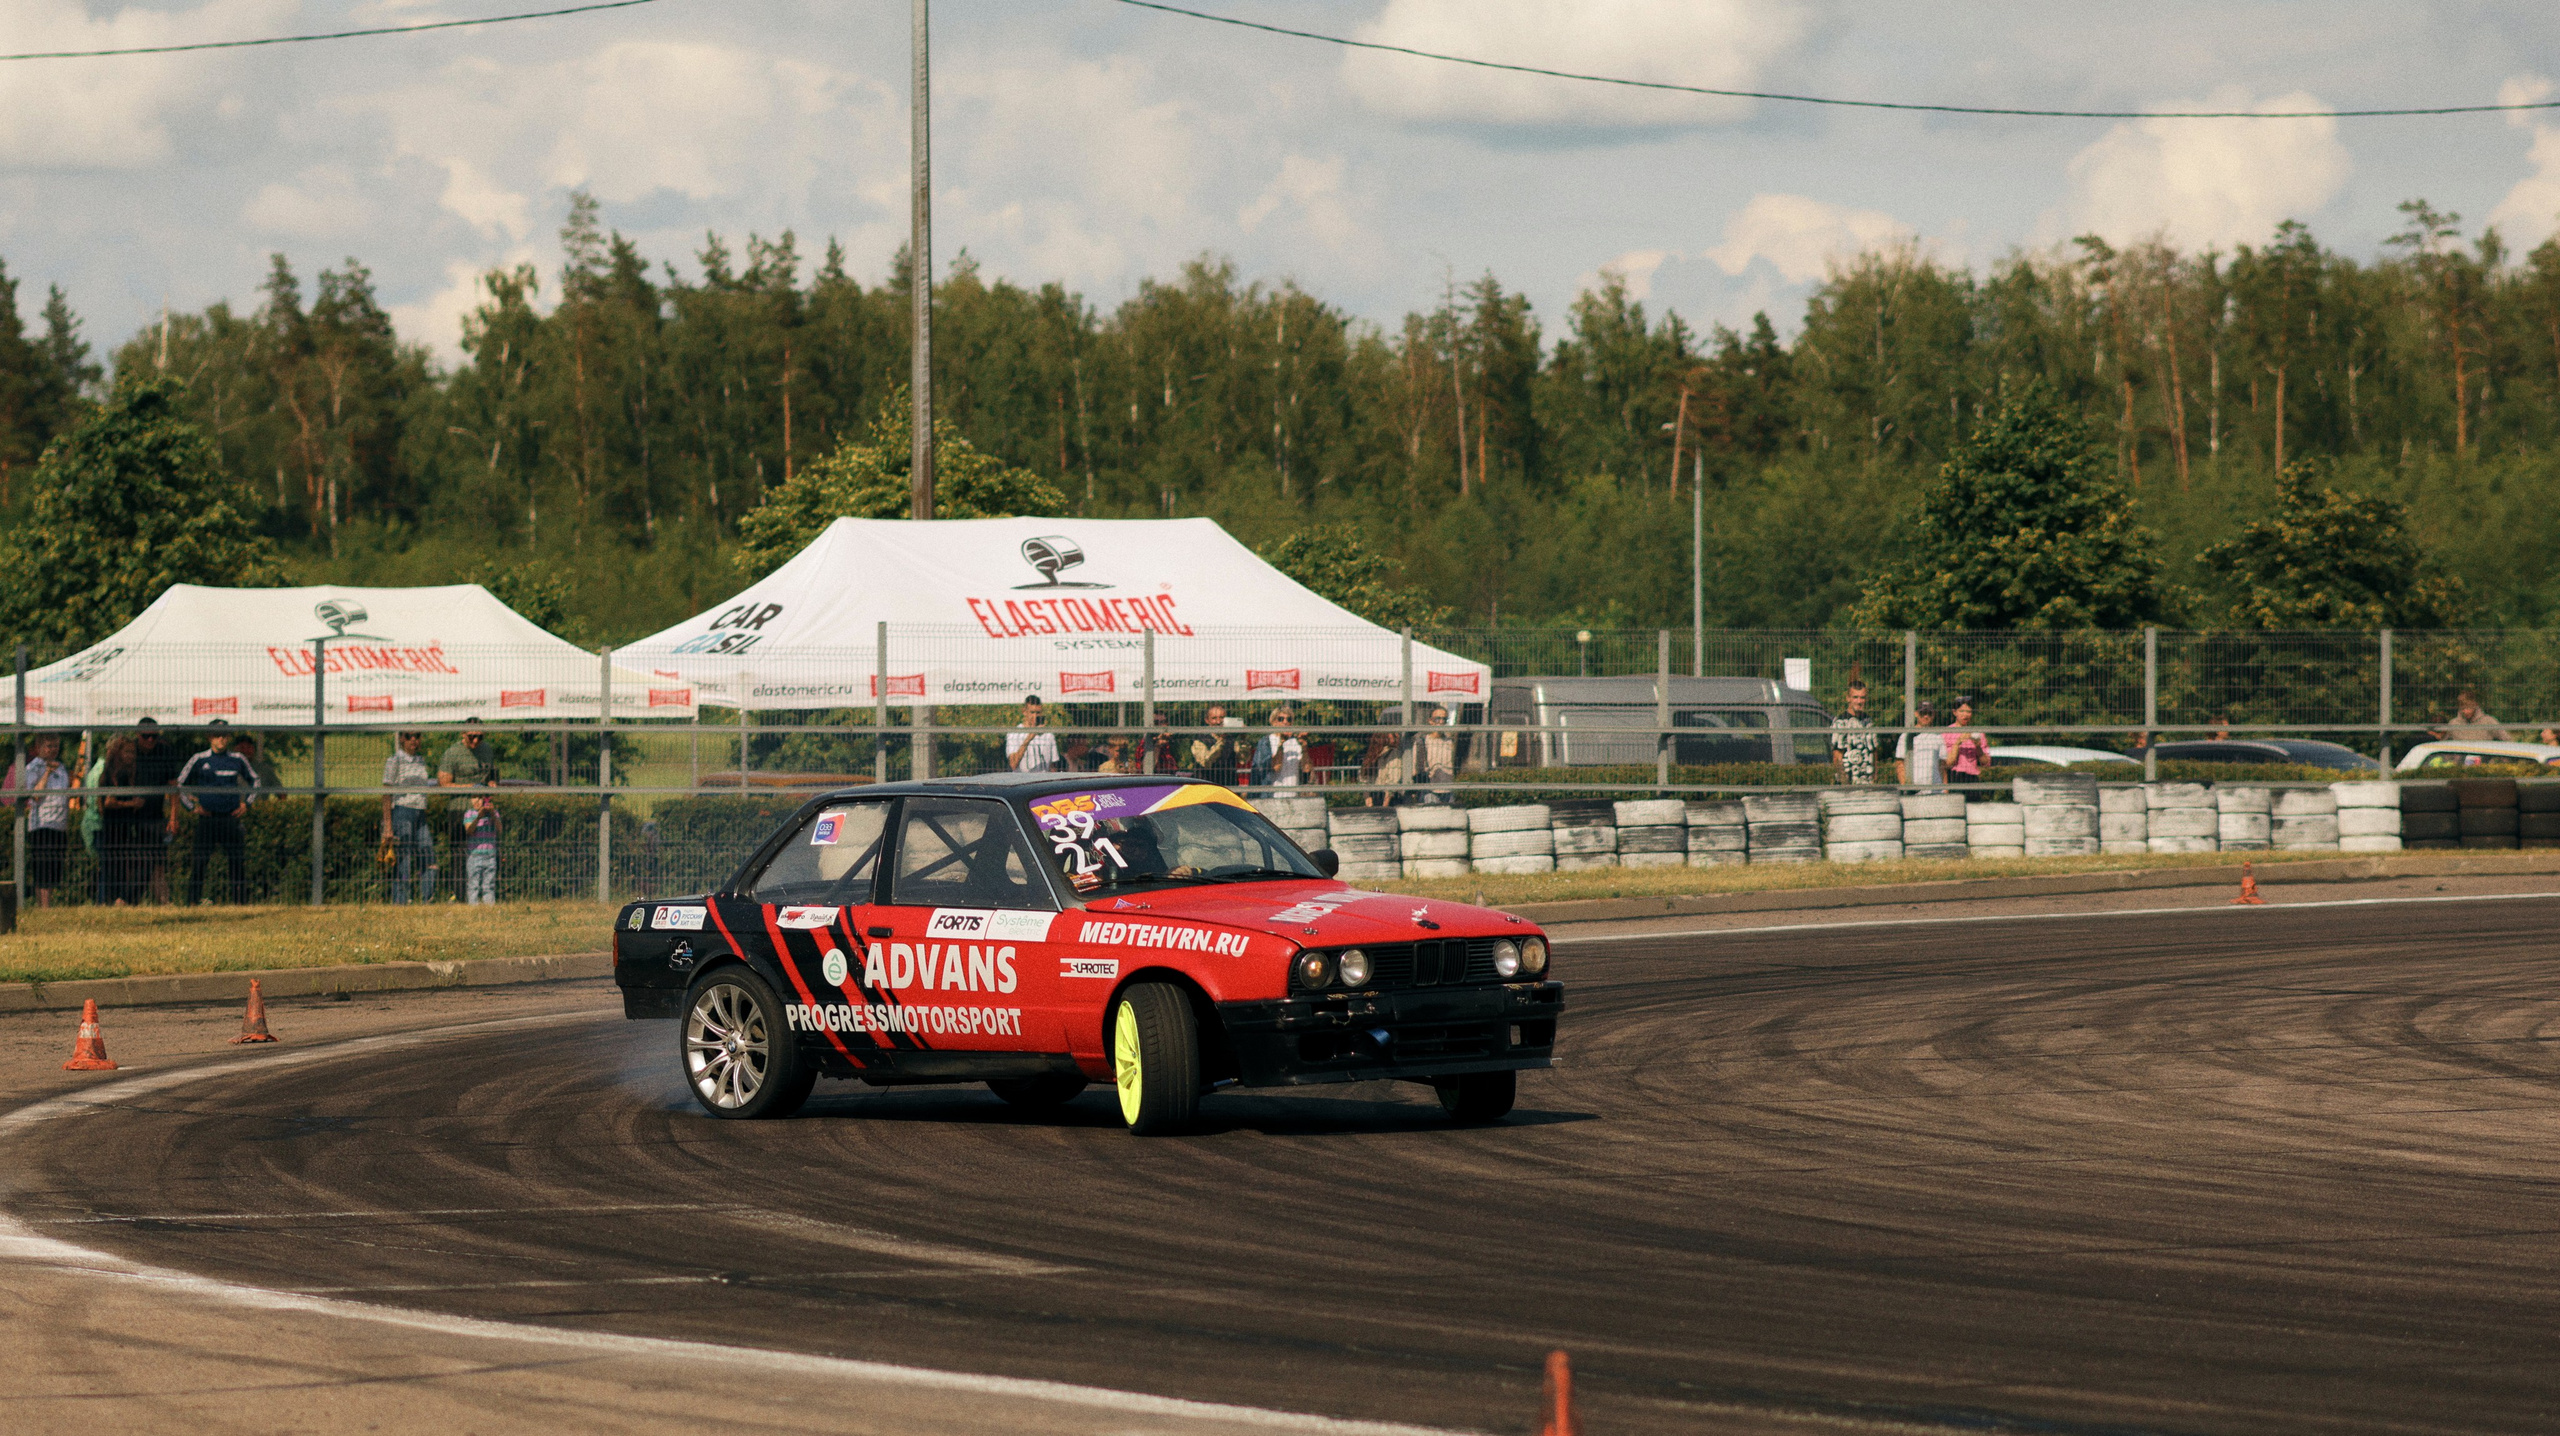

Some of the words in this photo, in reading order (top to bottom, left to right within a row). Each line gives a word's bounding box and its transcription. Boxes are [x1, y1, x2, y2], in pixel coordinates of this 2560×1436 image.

[708, 602, 784, 631] CAR
[965, 594, 1195, 638] ELASTOMERIC
[752, 681, 853, 697] elastomeric.ru
[943, 678, 1043, 693] elastomeric.ru
[1132, 675, 1229, 689] elstomeric.ru
[1316, 674, 1403, 689] elastomeric.r
[1040, 810, 1095, 843] 39
[1054, 837, 1129, 874] 21
[934, 914, 984, 931] FORTIS
[1078, 921, 1250, 958] MEDTEHVRN.RU
[864, 943, 1018, 994] ADVANS
[1070, 963, 1115, 975] SUPROTEC
[785, 1003, 1022, 1037] PROGRESSMOTORSPORT
